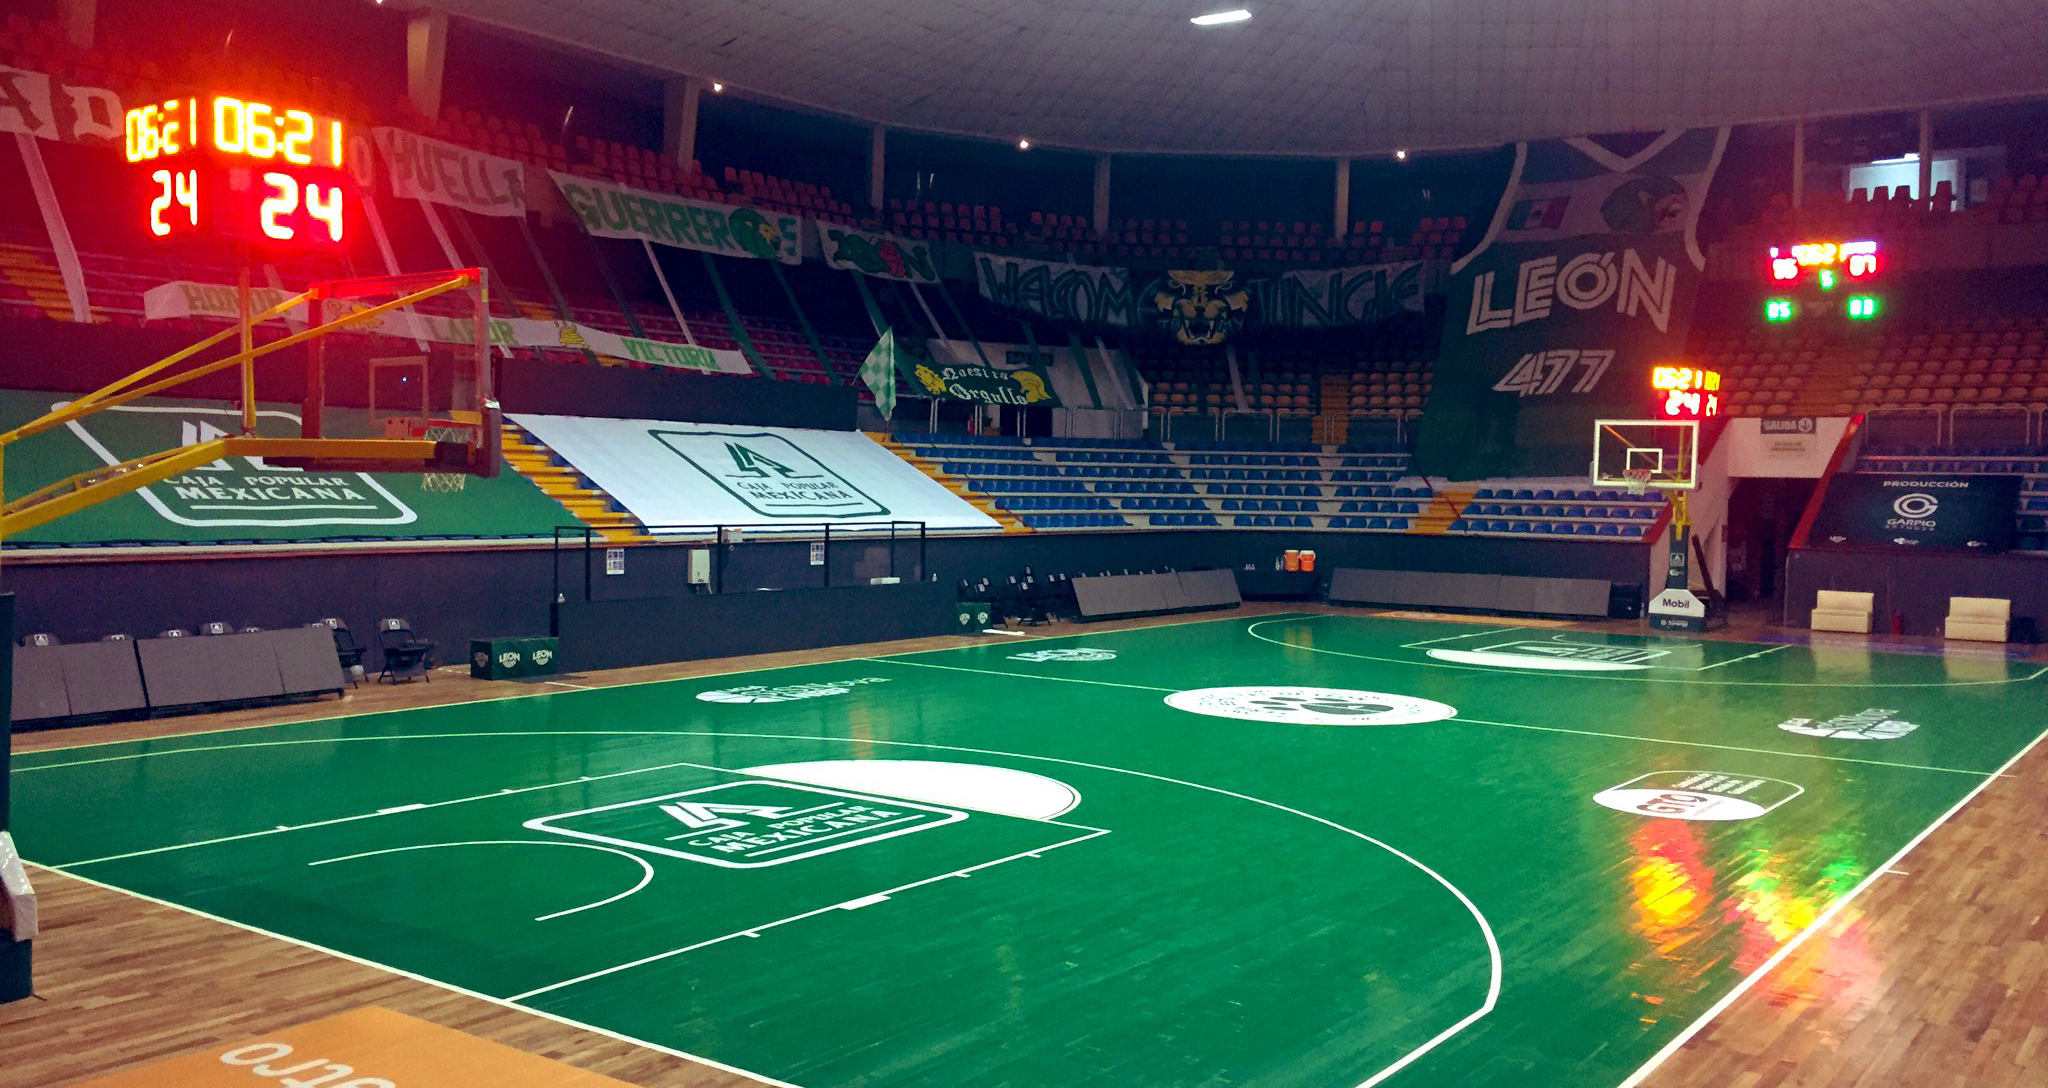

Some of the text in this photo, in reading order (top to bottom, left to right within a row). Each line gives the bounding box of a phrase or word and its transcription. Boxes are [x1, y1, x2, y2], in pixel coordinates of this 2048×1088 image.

[125, 97, 197, 163] 06:21
[213, 96, 343, 168] 06:21
[149, 169, 198, 237] 24
[260, 171, 344, 243] 24
[1491, 349, 1617, 397] 477
[949, 383, 1028, 406] Orgullo
[1665, 389, 1700, 416] 24
[173, 486, 366, 500] MEXICANA
[243, 476, 350, 486] POPULAR
[736, 481, 839, 492] CAJA POPULAR
[749, 489, 853, 501] MEXICANA
[1662, 598, 1690, 609] Mobil
[688, 805, 875, 846] CAJA POPULAR
[710, 809, 903, 854] MEXICANA
